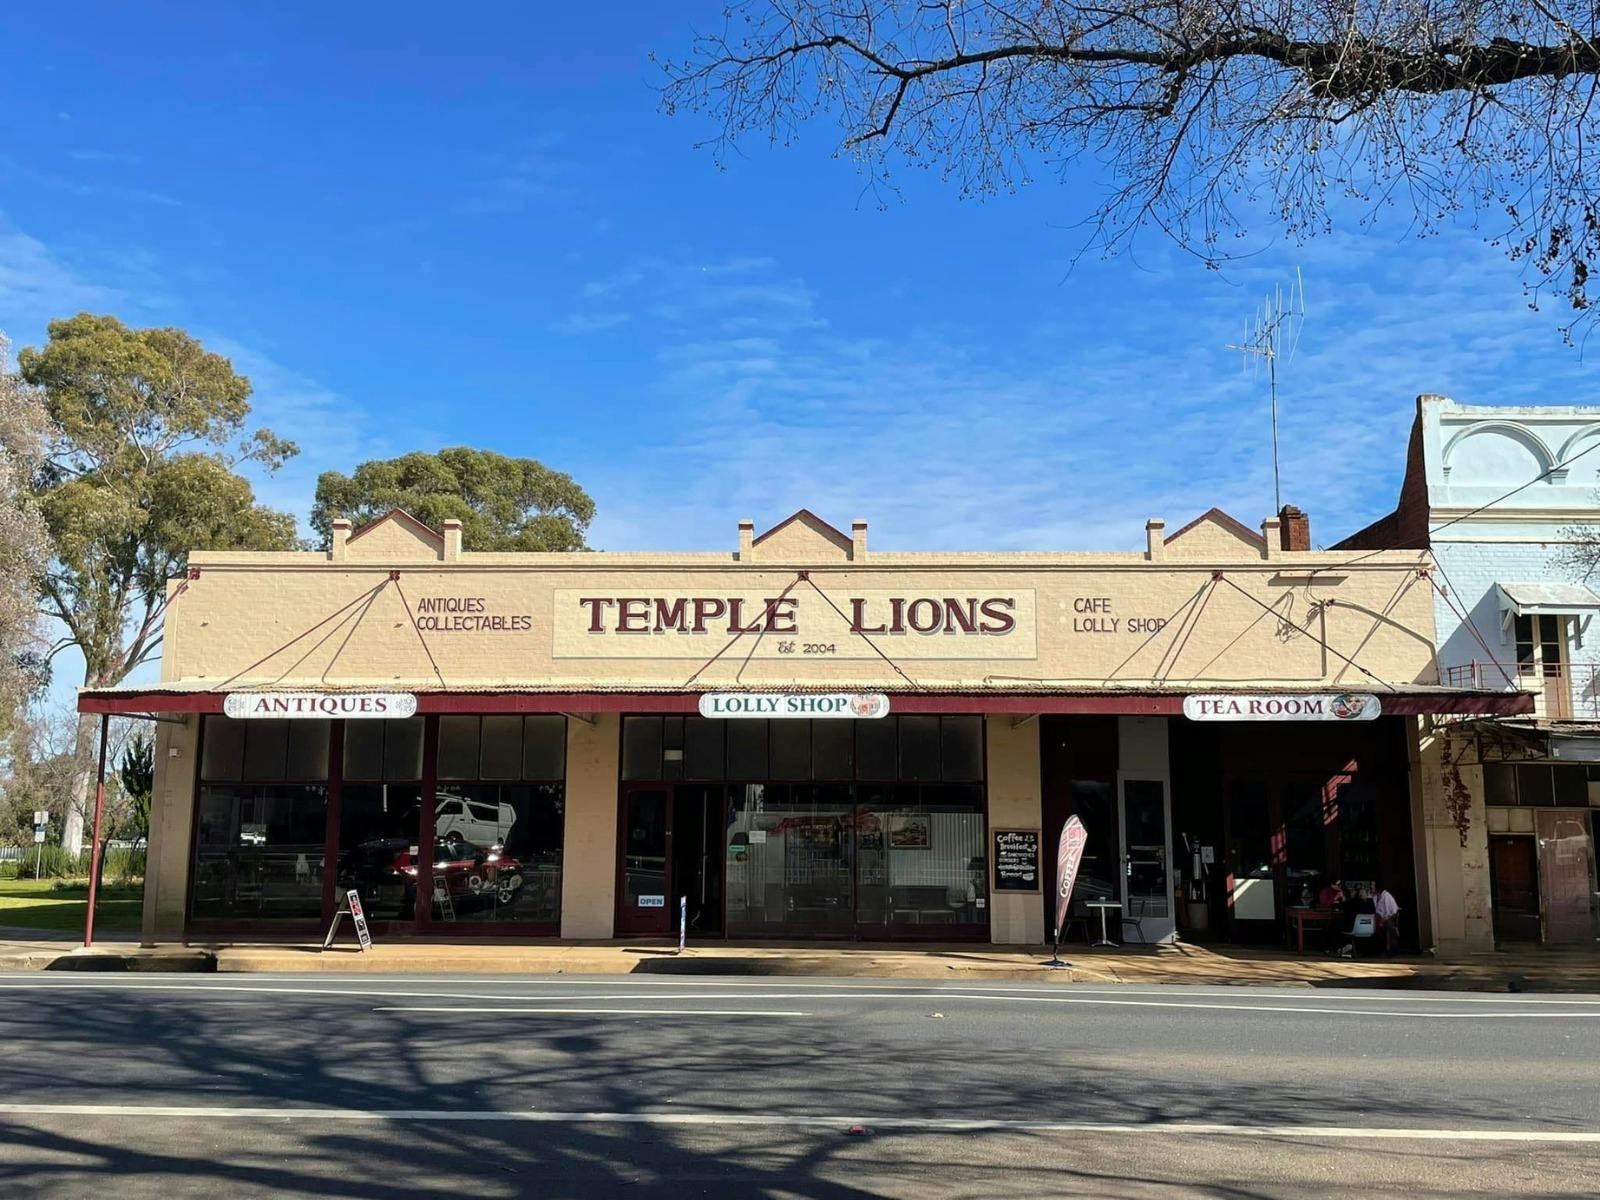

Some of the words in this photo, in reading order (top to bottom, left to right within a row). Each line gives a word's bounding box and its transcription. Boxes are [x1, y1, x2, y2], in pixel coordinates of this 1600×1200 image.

[418, 598, 485, 612] ANTIQUES
[1074, 598, 1111, 613] CAFE
[417, 616, 532, 630] COLLECTABLES
[580, 598, 799, 634] TEMPLE
[849, 597, 1016, 635] LIONS
[1074, 618, 1119, 632] LOLLY
[1127, 618, 1166, 632] SHOP
[803, 643, 836, 654] 2004
[254, 697, 387, 715] ANTIQUES
[713, 697, 780, 712] LOLLY
[787, 697, 847, 712] SHOP
[1197, 699, 1242, 714] TEA
[1249, 699, 1324, 714] ROOM
[997, 833, 1023, 843] Coffee
